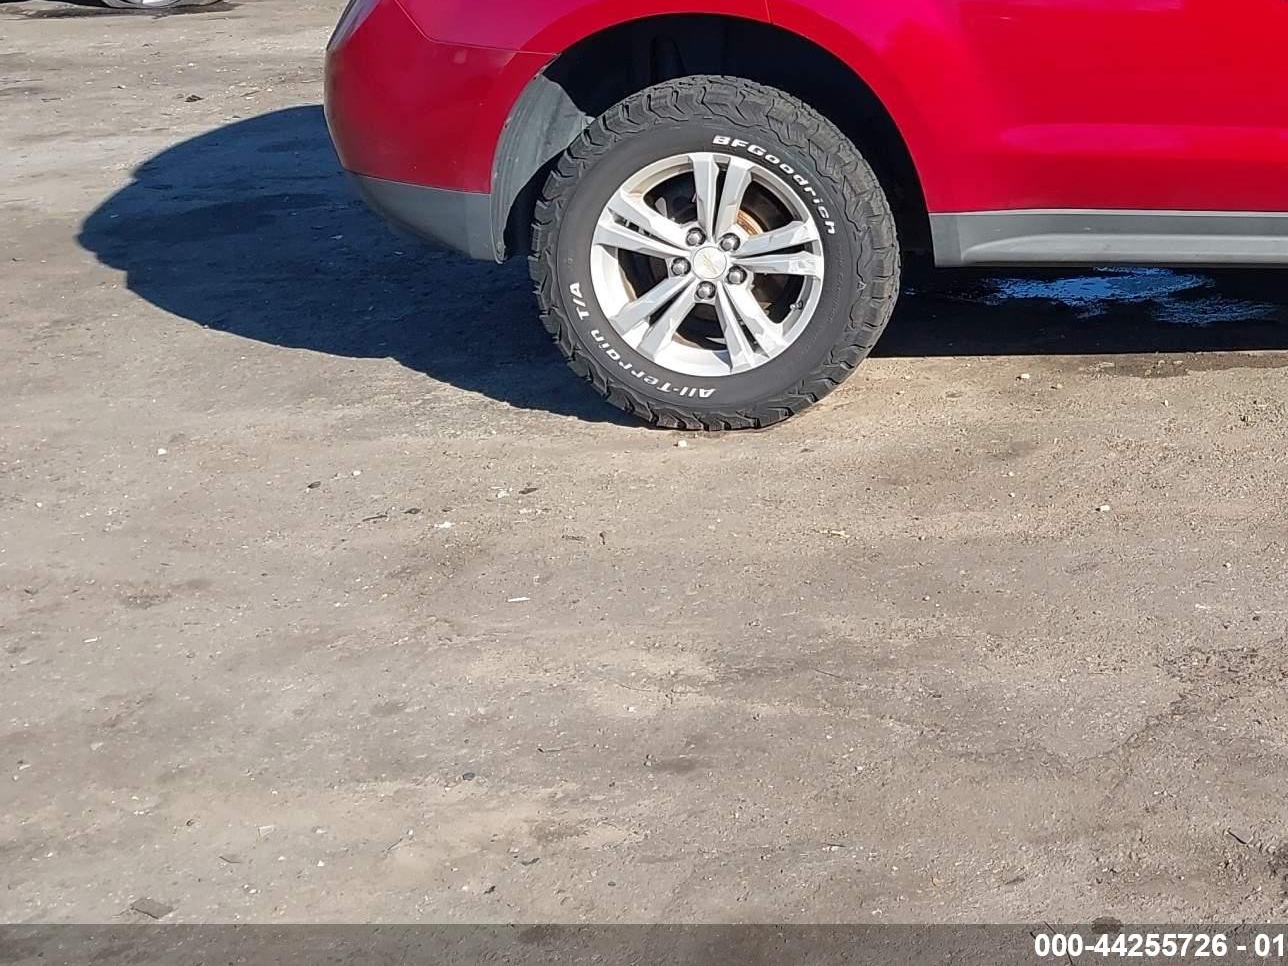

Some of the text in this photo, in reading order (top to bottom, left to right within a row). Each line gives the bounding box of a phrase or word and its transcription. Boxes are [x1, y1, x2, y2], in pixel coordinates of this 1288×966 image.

[712, 134, 836, 235] BFGoodrich
[569, 281, 716, 399] All-Terrain T/A
